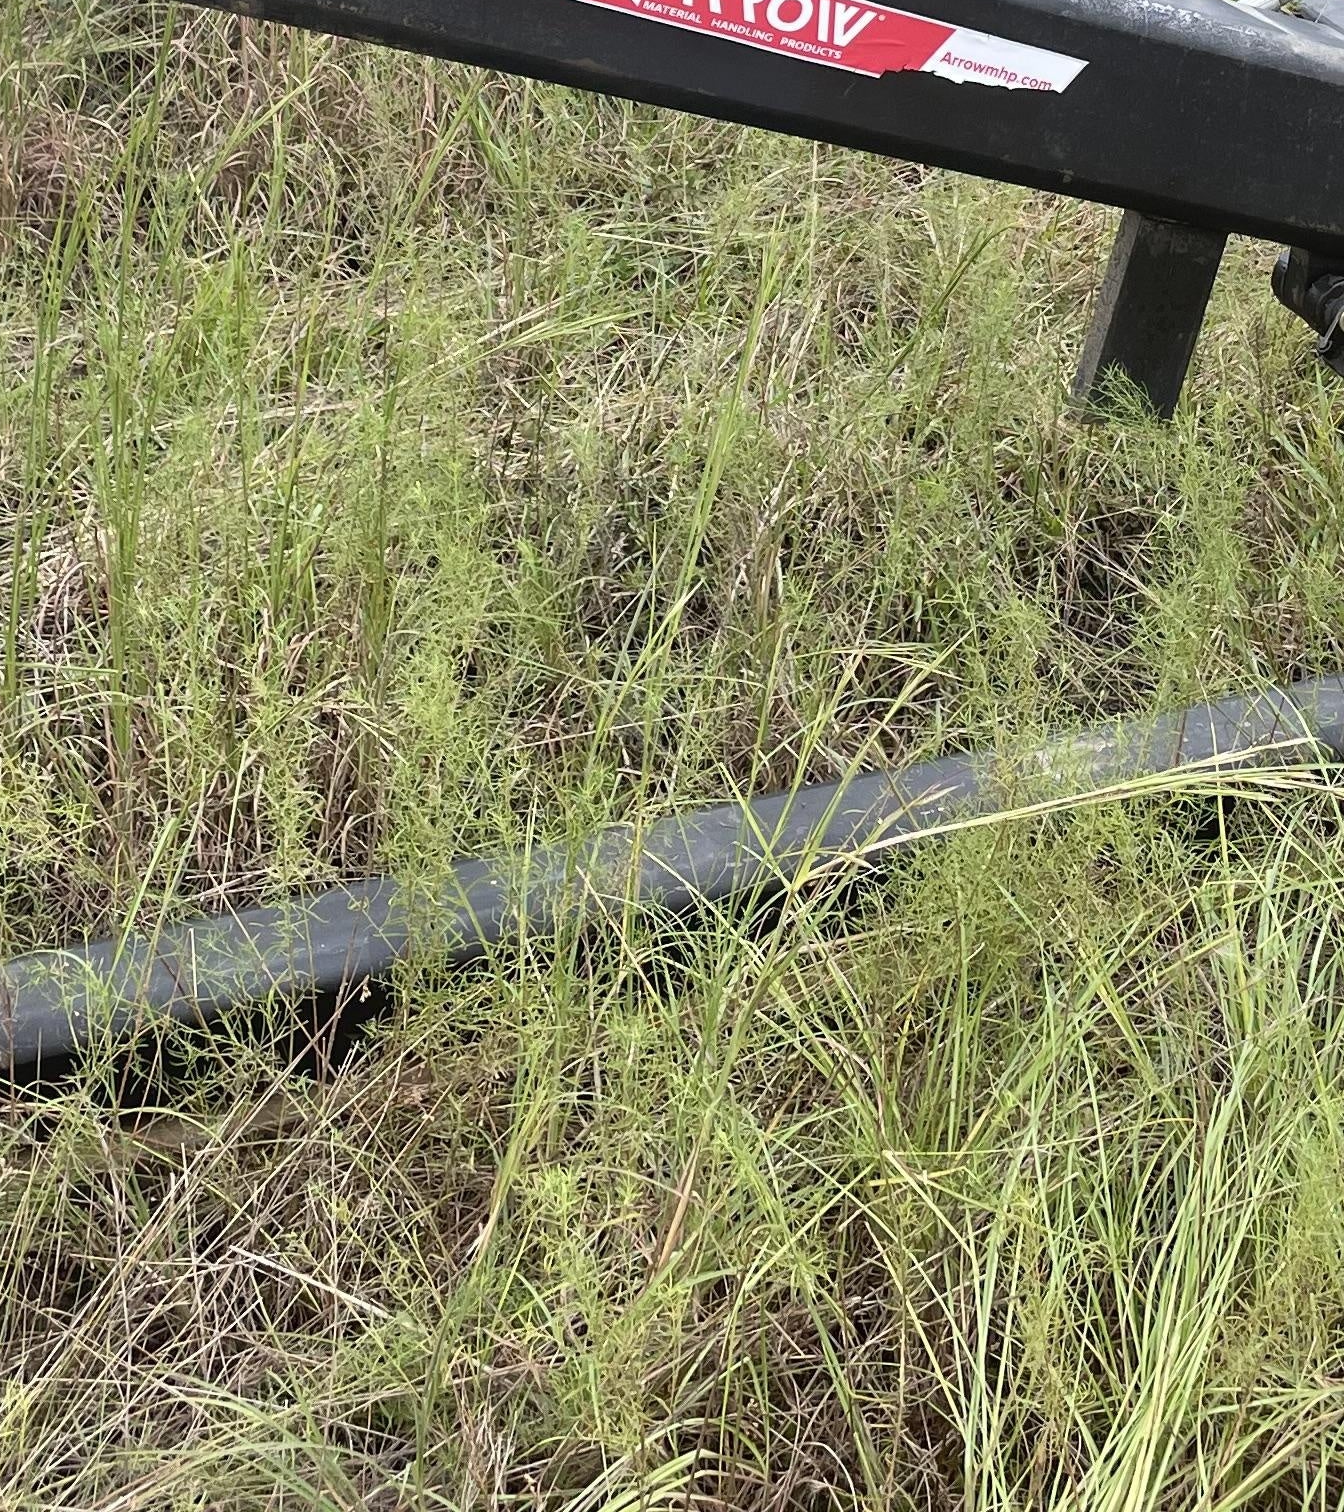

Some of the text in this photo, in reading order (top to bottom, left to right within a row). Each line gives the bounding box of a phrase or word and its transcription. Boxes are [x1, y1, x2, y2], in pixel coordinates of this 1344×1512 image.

[642, 1, 843, 60] MATERIAL HANDLING PRODUCTS
[940, 51, 1052, 91] Arrowmhp.com
